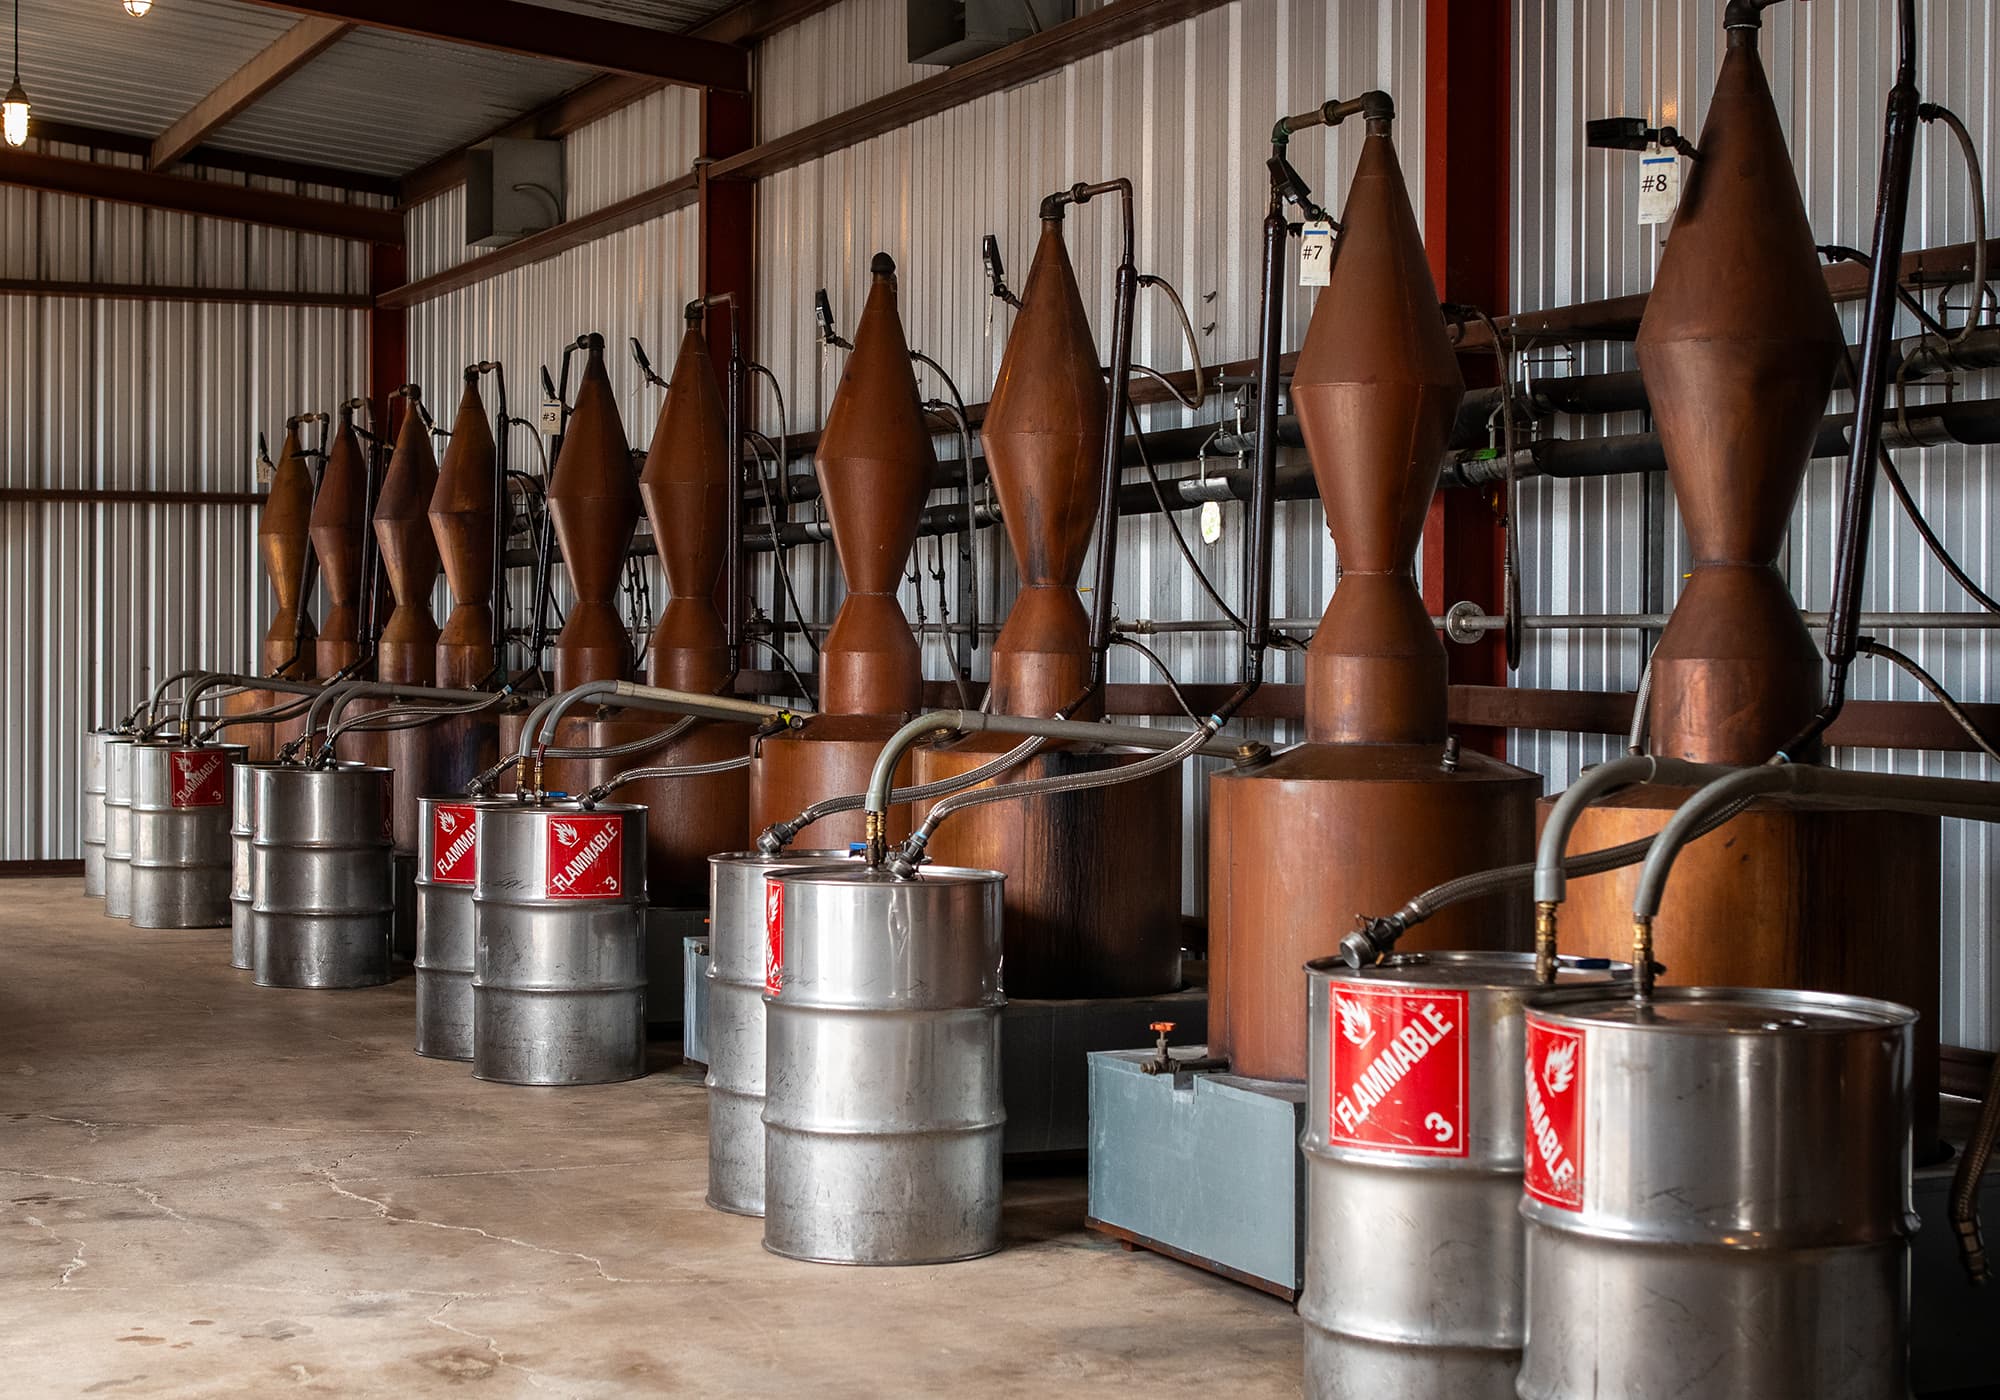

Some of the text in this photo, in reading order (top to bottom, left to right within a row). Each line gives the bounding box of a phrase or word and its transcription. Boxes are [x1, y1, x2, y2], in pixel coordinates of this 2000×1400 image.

[1642, 174, 1667, 193] #8
[1303, 245, 1323, 260] #7
[543, 412, 556, 421] #3
[176, 755, 221, 802] FLAMMABLE
[552, 821, 618, 892] FLAMMABLE
[605, 875, 618, 891] 3
[1336, 1002, 1454, 1134] FLAMMABLE
[1424, 1112, 1454, 1142] 3
